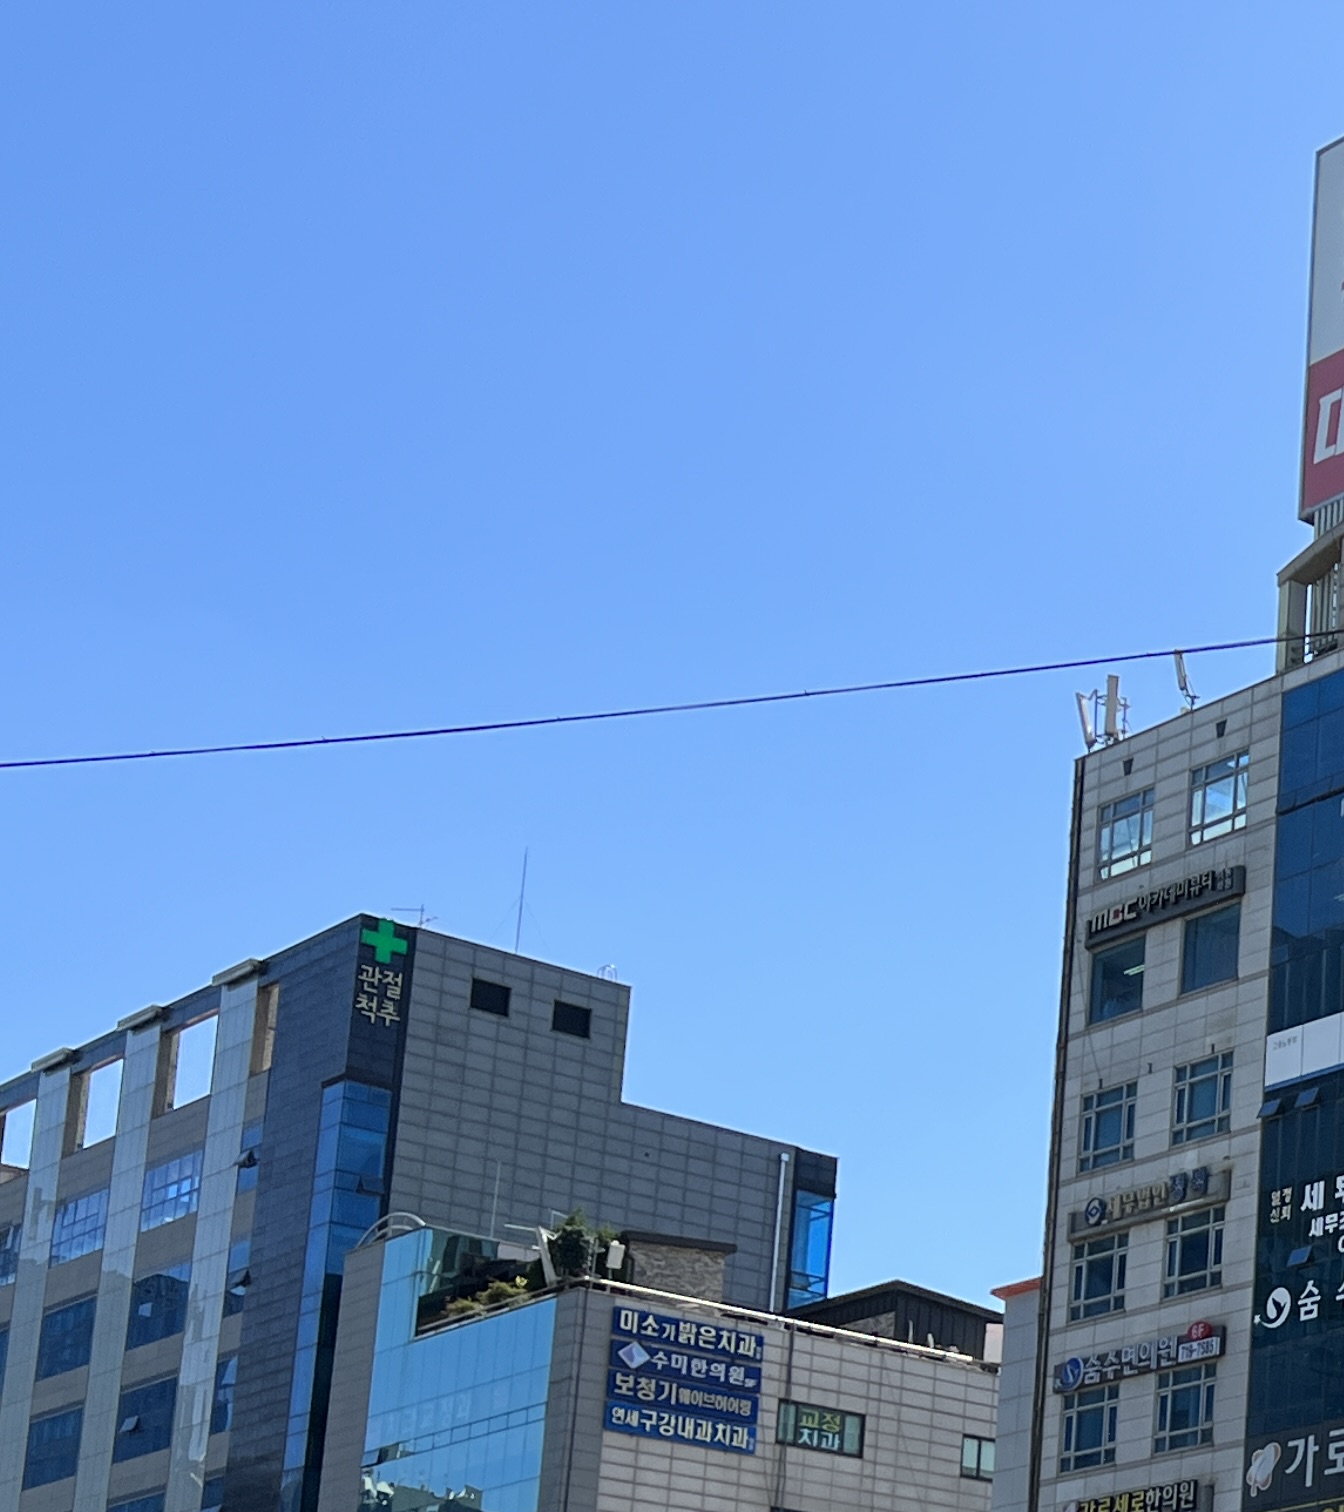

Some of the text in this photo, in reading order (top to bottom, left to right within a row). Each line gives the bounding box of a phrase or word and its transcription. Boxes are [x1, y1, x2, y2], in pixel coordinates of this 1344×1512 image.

[358, 965, 402, 1000] 관절
[355, 993, 400, 1027] 척추
[620, 1309, 757, 1358] 미소가밝은치과
[650, 1351, 746, 1385] 수미한의원
[1083, 1336, 1177, 1384] 숨수면의원
[615, 1372, 677, 1405] 보청기
[800, 1410, 841, 1432] 교정
[798, 1430, 840, 1450] 치과
